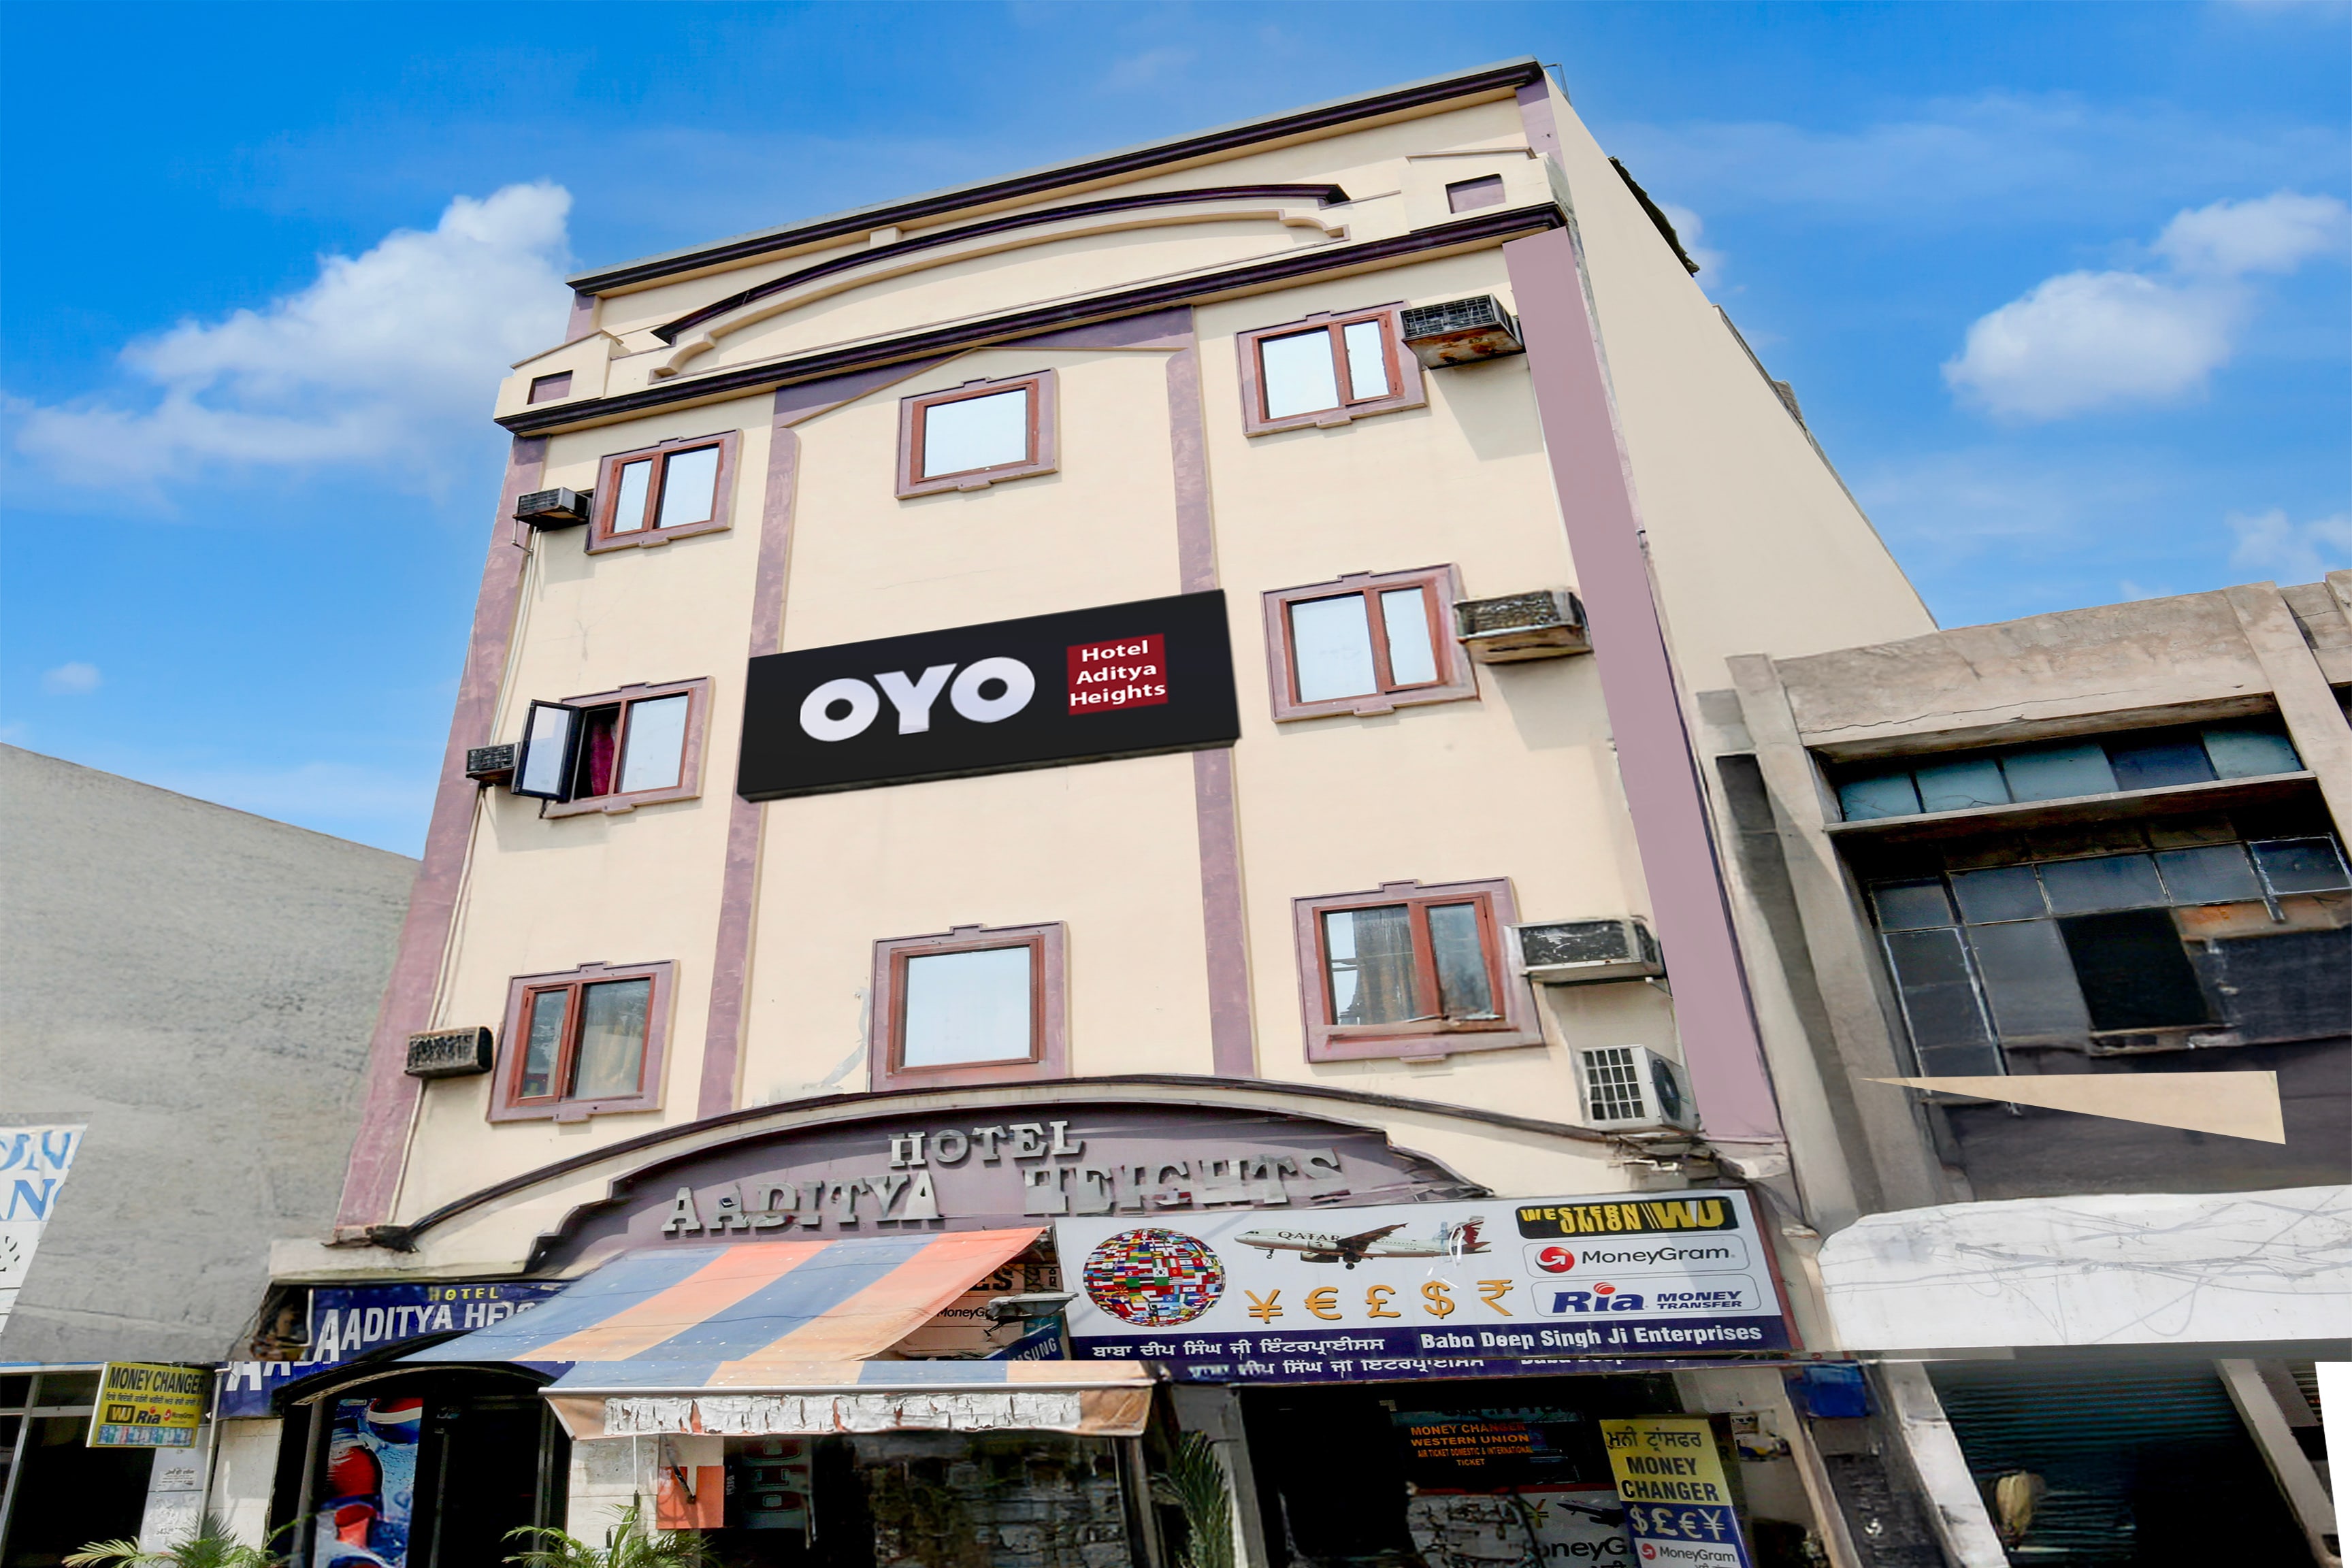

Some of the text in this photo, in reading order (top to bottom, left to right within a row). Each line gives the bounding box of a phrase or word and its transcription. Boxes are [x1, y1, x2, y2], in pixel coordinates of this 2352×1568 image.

[1081, 639, 1149, 662] Hotel
[1075, 662, 1158, 686] Aditya
[800, 656, 1036, 742] OYO
[1069, 681, 1166, 707] Heights
[887, 1120, 1085, 1168] HOTEL
[1651, 1199, 1725, 1229] WU
[1582, 1247, 1729, 1265] MoneyGram
[428, 1286, 499, 1302] HOTEL
[1552, 1282, 1742, 1313] Ria MONEY
[1656, 1301, 1742, 1309] TRANSFER
[312, 1304, 453, 1361] AADITYA
[1420, 1333, 1475, 1349] Baba
[1539, 1328, 1602, 1349] Singh
[1607, 1328, 1629, 1344] Ji
[1634, 1324, 1763, 1347] Enterprises
[1092, 1344, 1132, 1358] ਬਾਬਾ
[1139, 1341, 1175, 1356] ਦੀਪ
[1182, 1339, 1222, 1356] ਸਿੰਘ
[1229, 1339, 1252, 1360] ਜੀ
[108, 1367, 154, 1390] MONEY
[135, 1406, 161, 1424] Ria
[1410, 1422, 1527, 1435] MONEY CHANGER
[1411, 1434, 1530, 1446] WESTERN UNION
[1418, 1450, 1428, 1458] AIR
[1428, 1448, 1450, 1457] TICKET
[1451, 1448, 1480, 1456] DOMESTIC
[1487, 1444, 1533, 1455] INTERNATIONAL
[1456, 1458, 1485, 1466] TICKET
[1625, 1456, 1697, 1475] MONEY
[1621, 1480, 1720, 1501] CHANGER
[1660, 1546, 1735, 1562] MoneyGram
